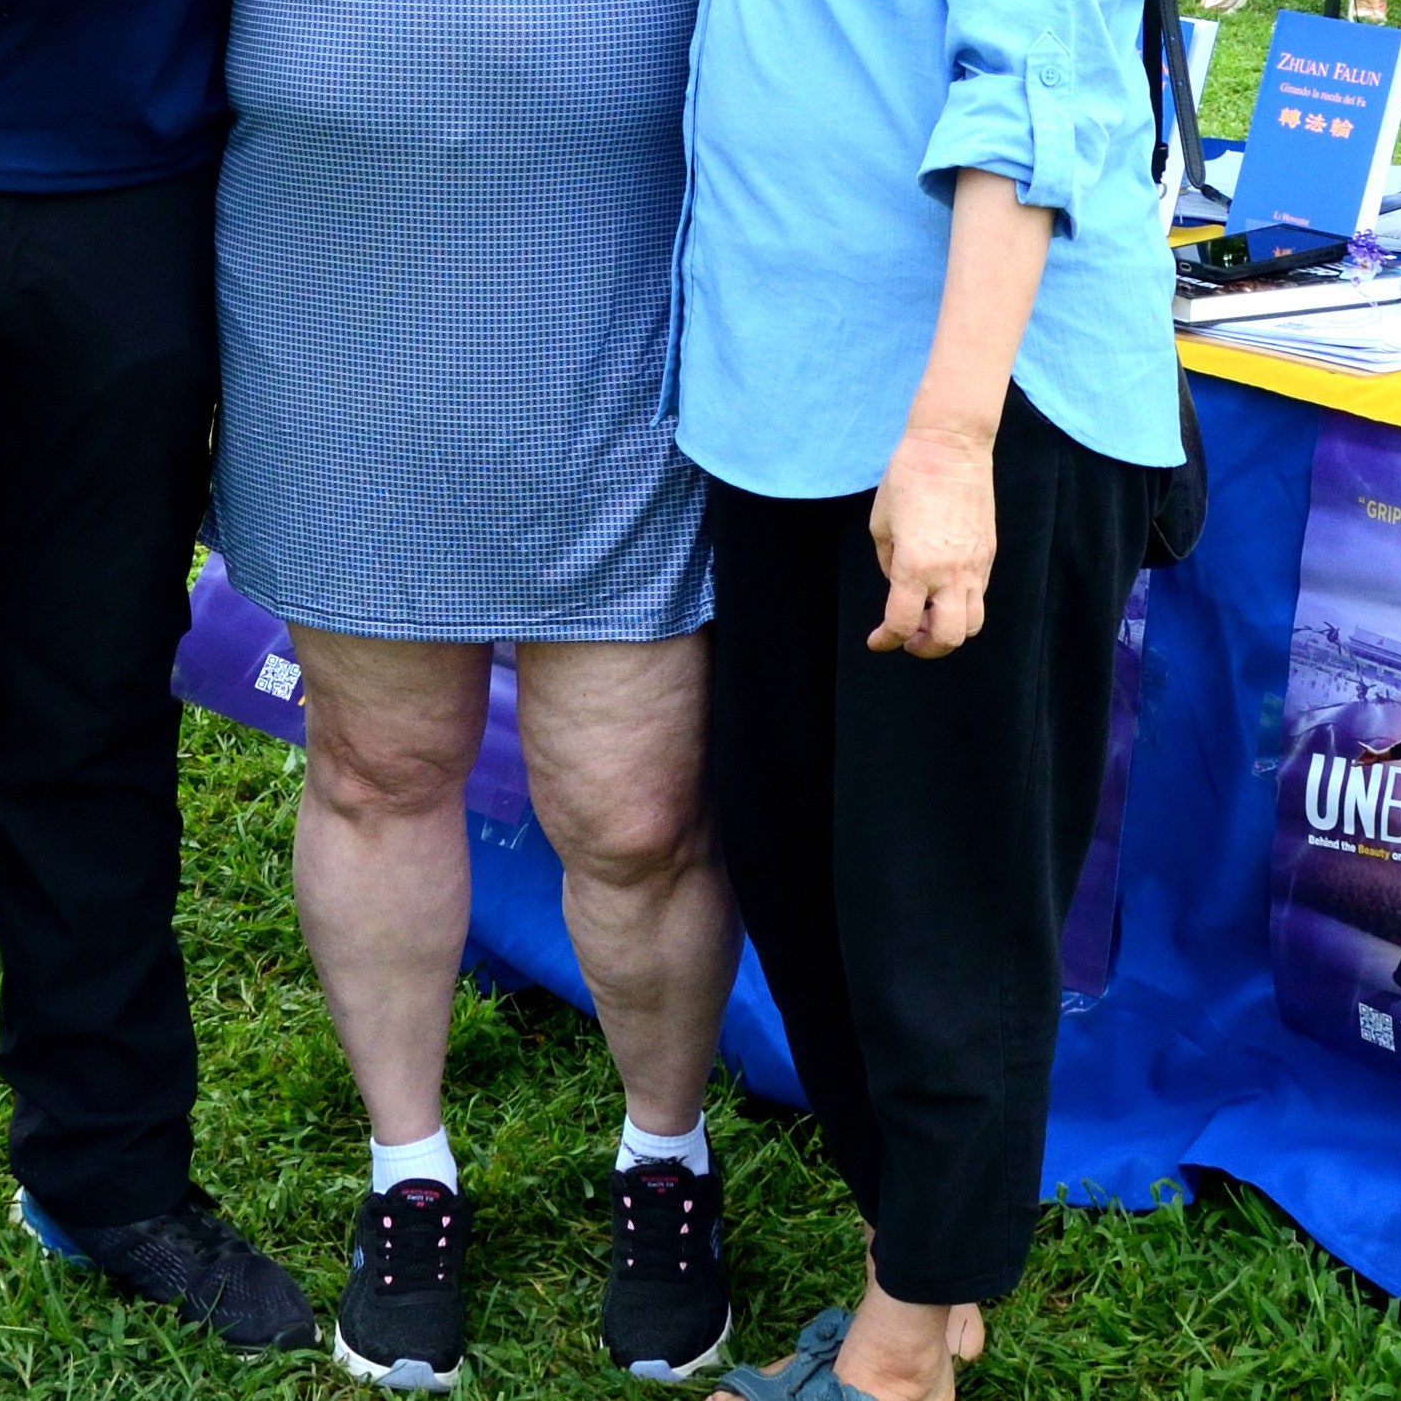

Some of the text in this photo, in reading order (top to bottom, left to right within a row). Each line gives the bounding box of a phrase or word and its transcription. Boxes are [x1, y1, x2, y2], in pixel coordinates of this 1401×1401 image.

[1277, 51, 1382, 87] ZHUAN FALUN
[1308, 834, 1340, 851] Behind
[1341, 840, 1356, 854] the
[1357, 842, 1390, 862] Beauty
